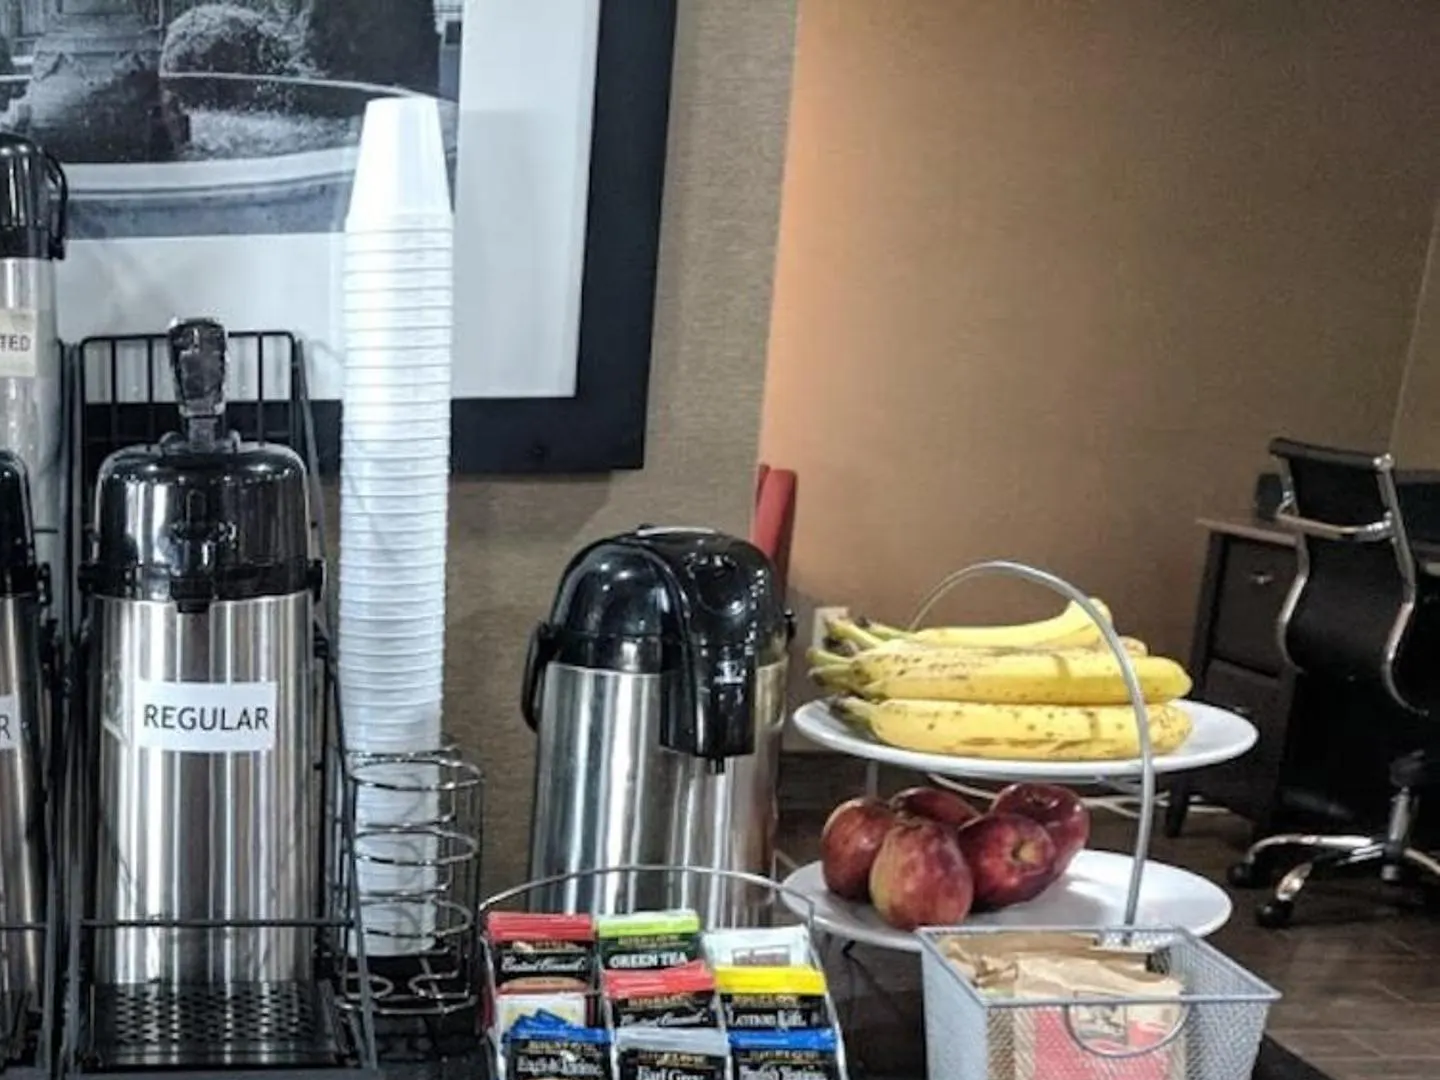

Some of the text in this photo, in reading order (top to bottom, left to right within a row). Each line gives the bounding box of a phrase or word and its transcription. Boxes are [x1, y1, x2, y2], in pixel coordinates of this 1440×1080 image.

[143, 703, 270, 731] REGULAR
[608, 951, 689, 969] GREEN TEA
